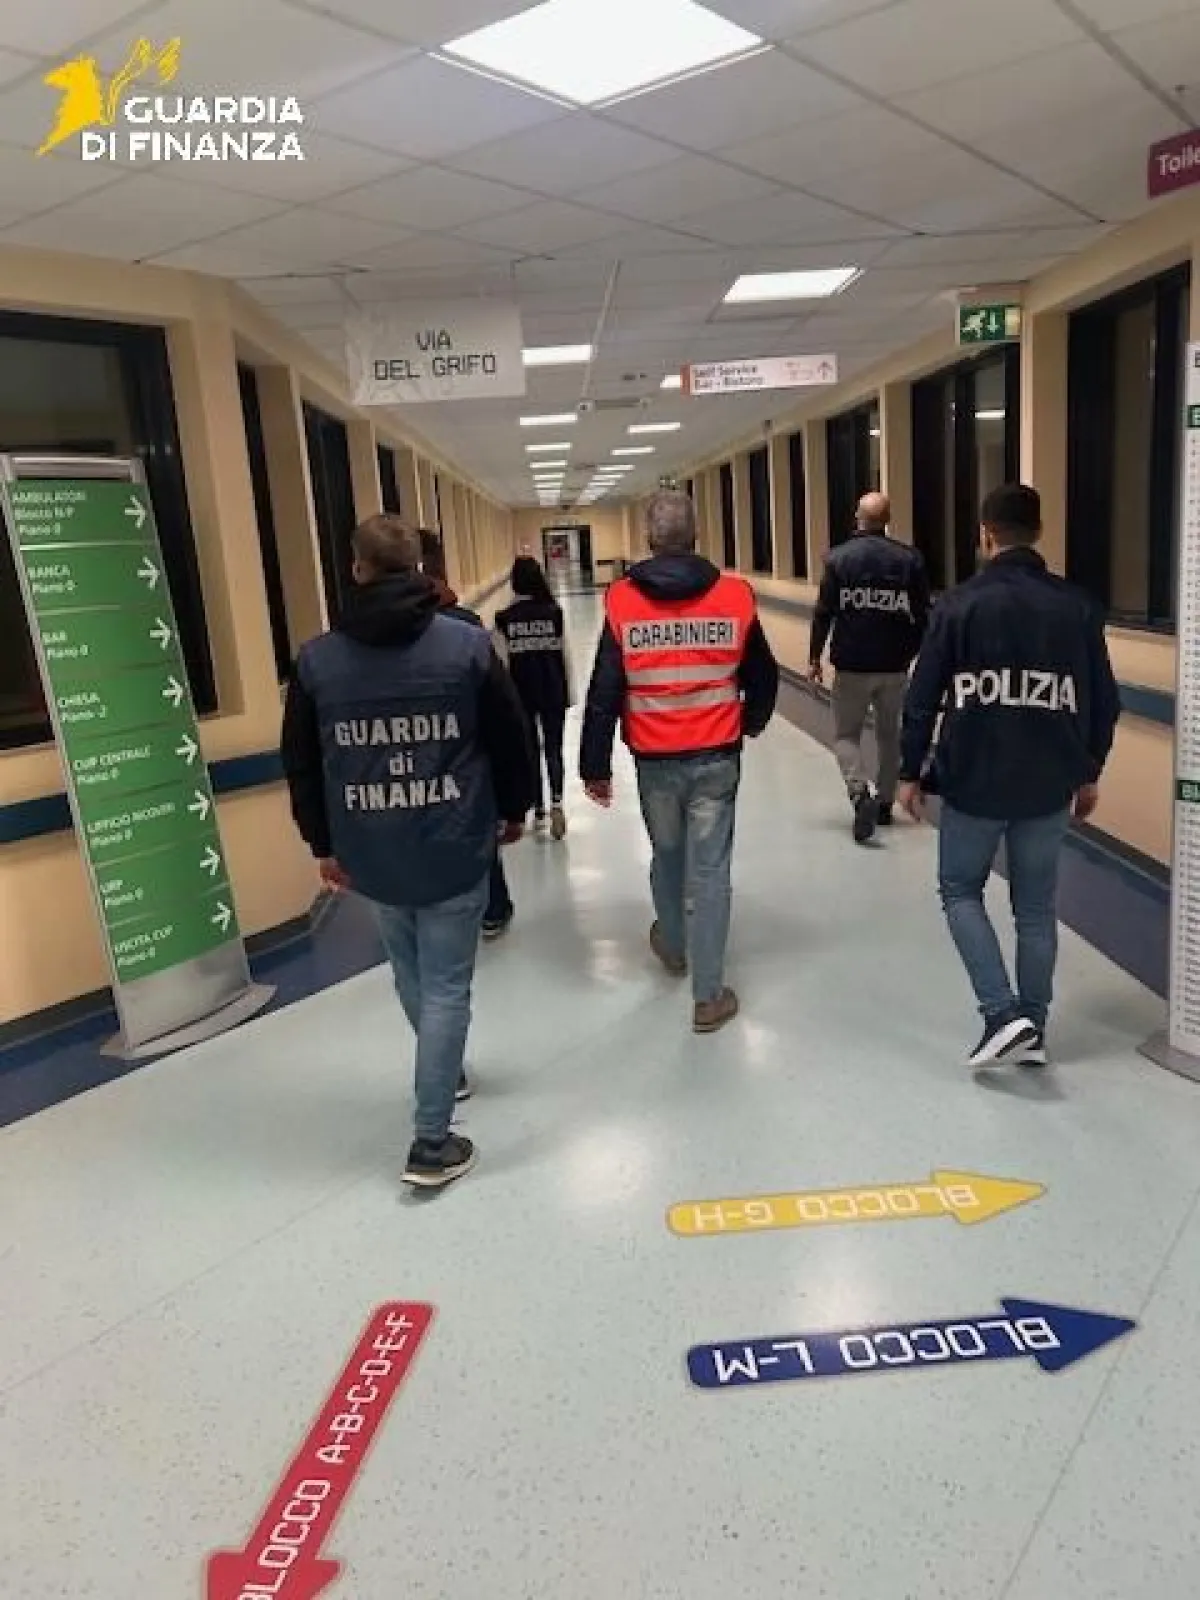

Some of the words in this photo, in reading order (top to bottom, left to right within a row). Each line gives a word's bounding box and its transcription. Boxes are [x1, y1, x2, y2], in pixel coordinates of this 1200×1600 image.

[415, 329, 452, 351] VIA
[374, 359, 421, 381] DEL
[432, 353, 496, 377] GRIFO
[840, 588, 911, 611] POLIZIA
[629, 621, 734, 649] CARABINIERI
[954, 668, 1078, 713] POLIZIA
[335, 713, 461, 746] GUARDIA
[389, 752, 414, 776] di
[344, 774, 461, 810] FINANZA
[693, 1203, 774, 1231] G-H
[797, 1184, 980, 1220] BLOCCO
[839, 1317, 1061, 1369] BLOCCO
[713, 1341, 816, 1383] L-M
[316, 1311, 414, 1464] A-B-C-D-E-F
